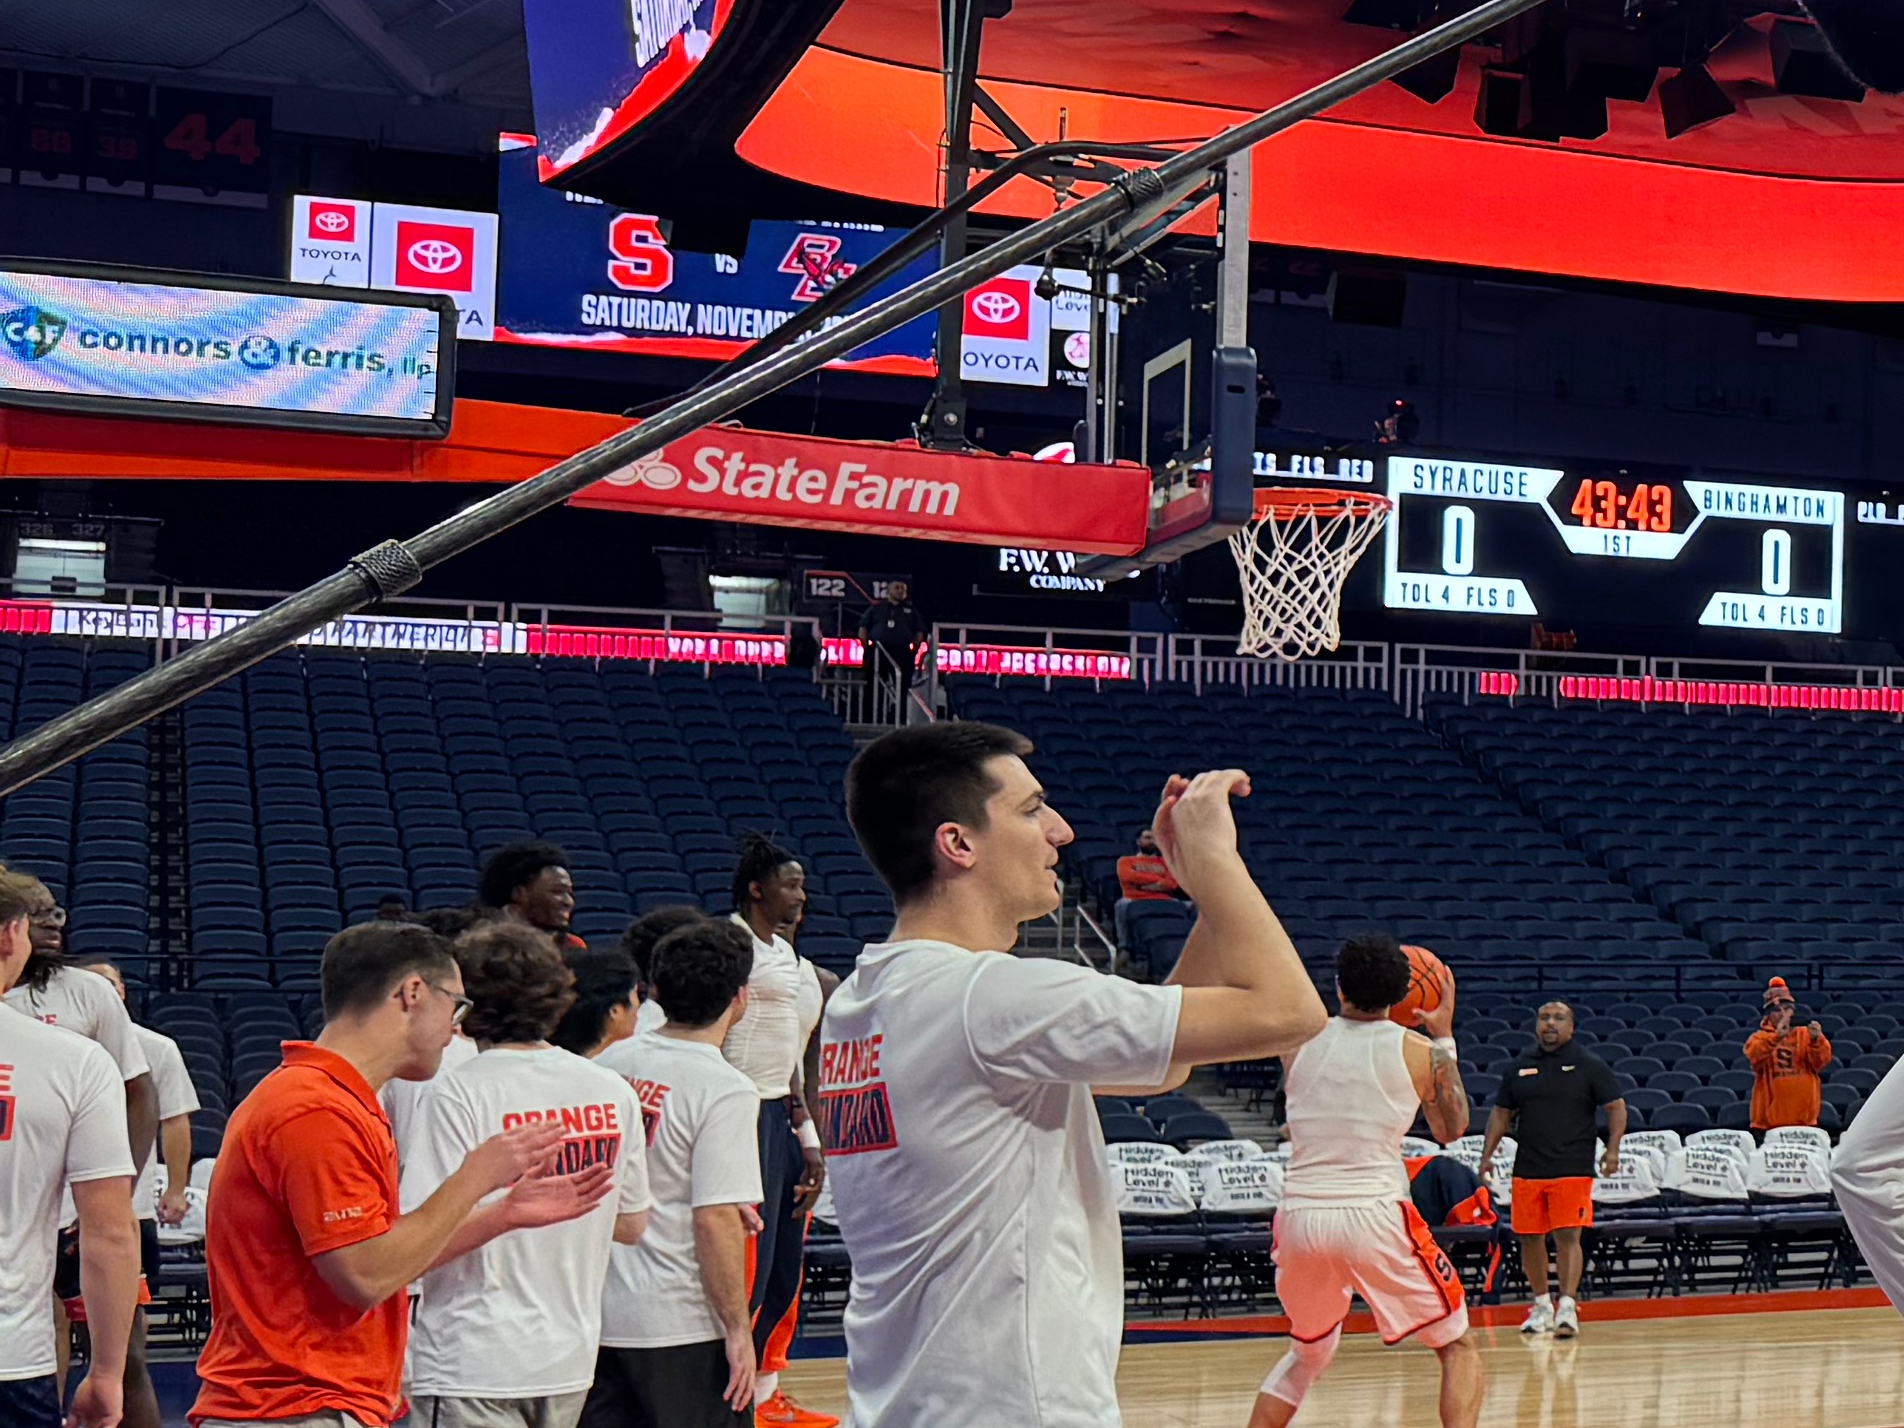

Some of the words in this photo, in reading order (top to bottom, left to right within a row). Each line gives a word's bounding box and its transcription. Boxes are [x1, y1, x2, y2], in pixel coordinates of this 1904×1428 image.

[164, 113, 261, 165] 44
[299, 247, 361, 262] TOYOTA
[607, 213, 674, 292] S
[581, 293, 694, 338] SATURDAY,
[78, 327, 231, 361] connors
[287, 340, 393, 378] ferris,
[963, 351, 1039, 373] OYOTA
[1414, 464, 1528, 497] SYRACUSE
[1571, 478, 1672, 532] 43:43
[1704, 489, 1825, 518] BINGHAMTON
[1442, 505, 1474, 575] 0
[1604, 534, 1631, 555] 1ST
[1000, 547, 1049, 573] F.W.
[1762, 528, 1791, 596] 0
[810, 578, 845, 597] 122
[1030, 573, 1106, 593] COMPANY
[1401, 582, 1431, 604] TOL
[1441, 585, 1450, 604] 4
[1466, 586, 1498, 607] FLS
[1507, 589, 1516, 607] 0
[1721, 602, 1748, 622] TOL
[1758, 604, 1765, 622] 4
[1780, 605, 1808, 625] FLS
[1817, 608, 1825, 626] 0
[1685, 1149, 1730, 1164] Hidden
[1763, 1149, 1809, 1164] Hidden
